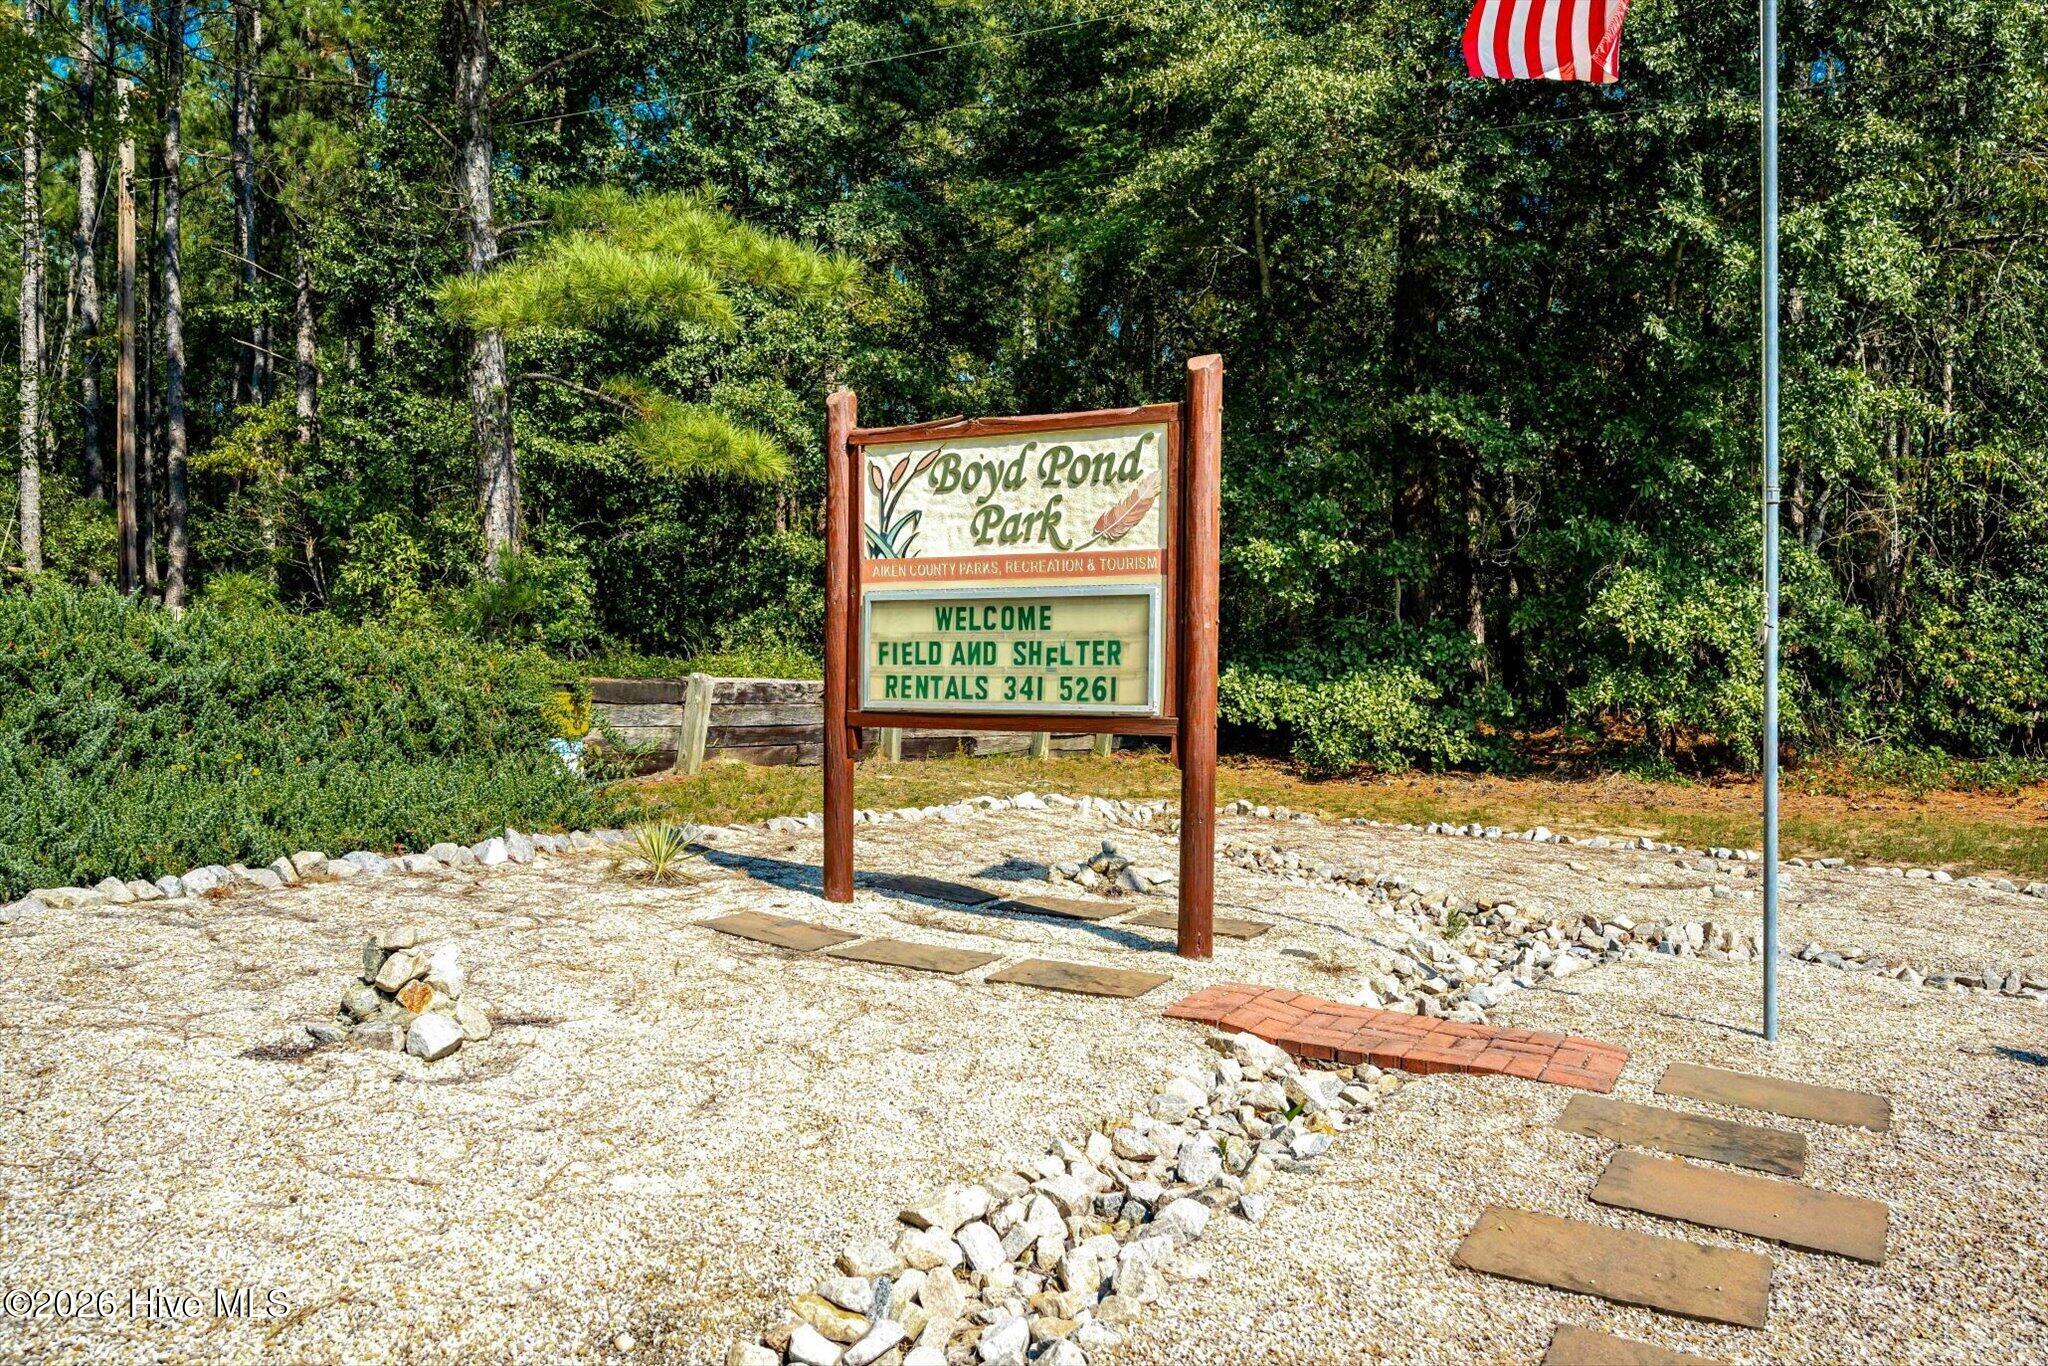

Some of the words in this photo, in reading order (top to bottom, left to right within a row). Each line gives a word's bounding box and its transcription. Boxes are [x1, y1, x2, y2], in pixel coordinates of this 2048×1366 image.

[928, 441, 1037, 504] Boyd
[1037, 432, 1154, 489] Pond
[971, 494, 1072, 551] Park
[872, 564, 906, 577] AIKEN
[909, 562, 956, 576] COUNTY
[959, 560, 1002, 575] PARKS,
[1005, 559, 1083, 573] RECREATION
[1087, 558, 1095, 571] &
[1099, 556, 1158, 570] TOURISM
[936, 606, 1051, 631] WELCOME
[878, 642, 941, 665] FIELD
[951, 641, 996, 665] AND
[1013, 640, 1121, 670] SHELTER
[885, 675, 988, 699] RENTALS
[1004, 676, 1042, 700] 341
[1059, 676, 1116, 701] 5261
